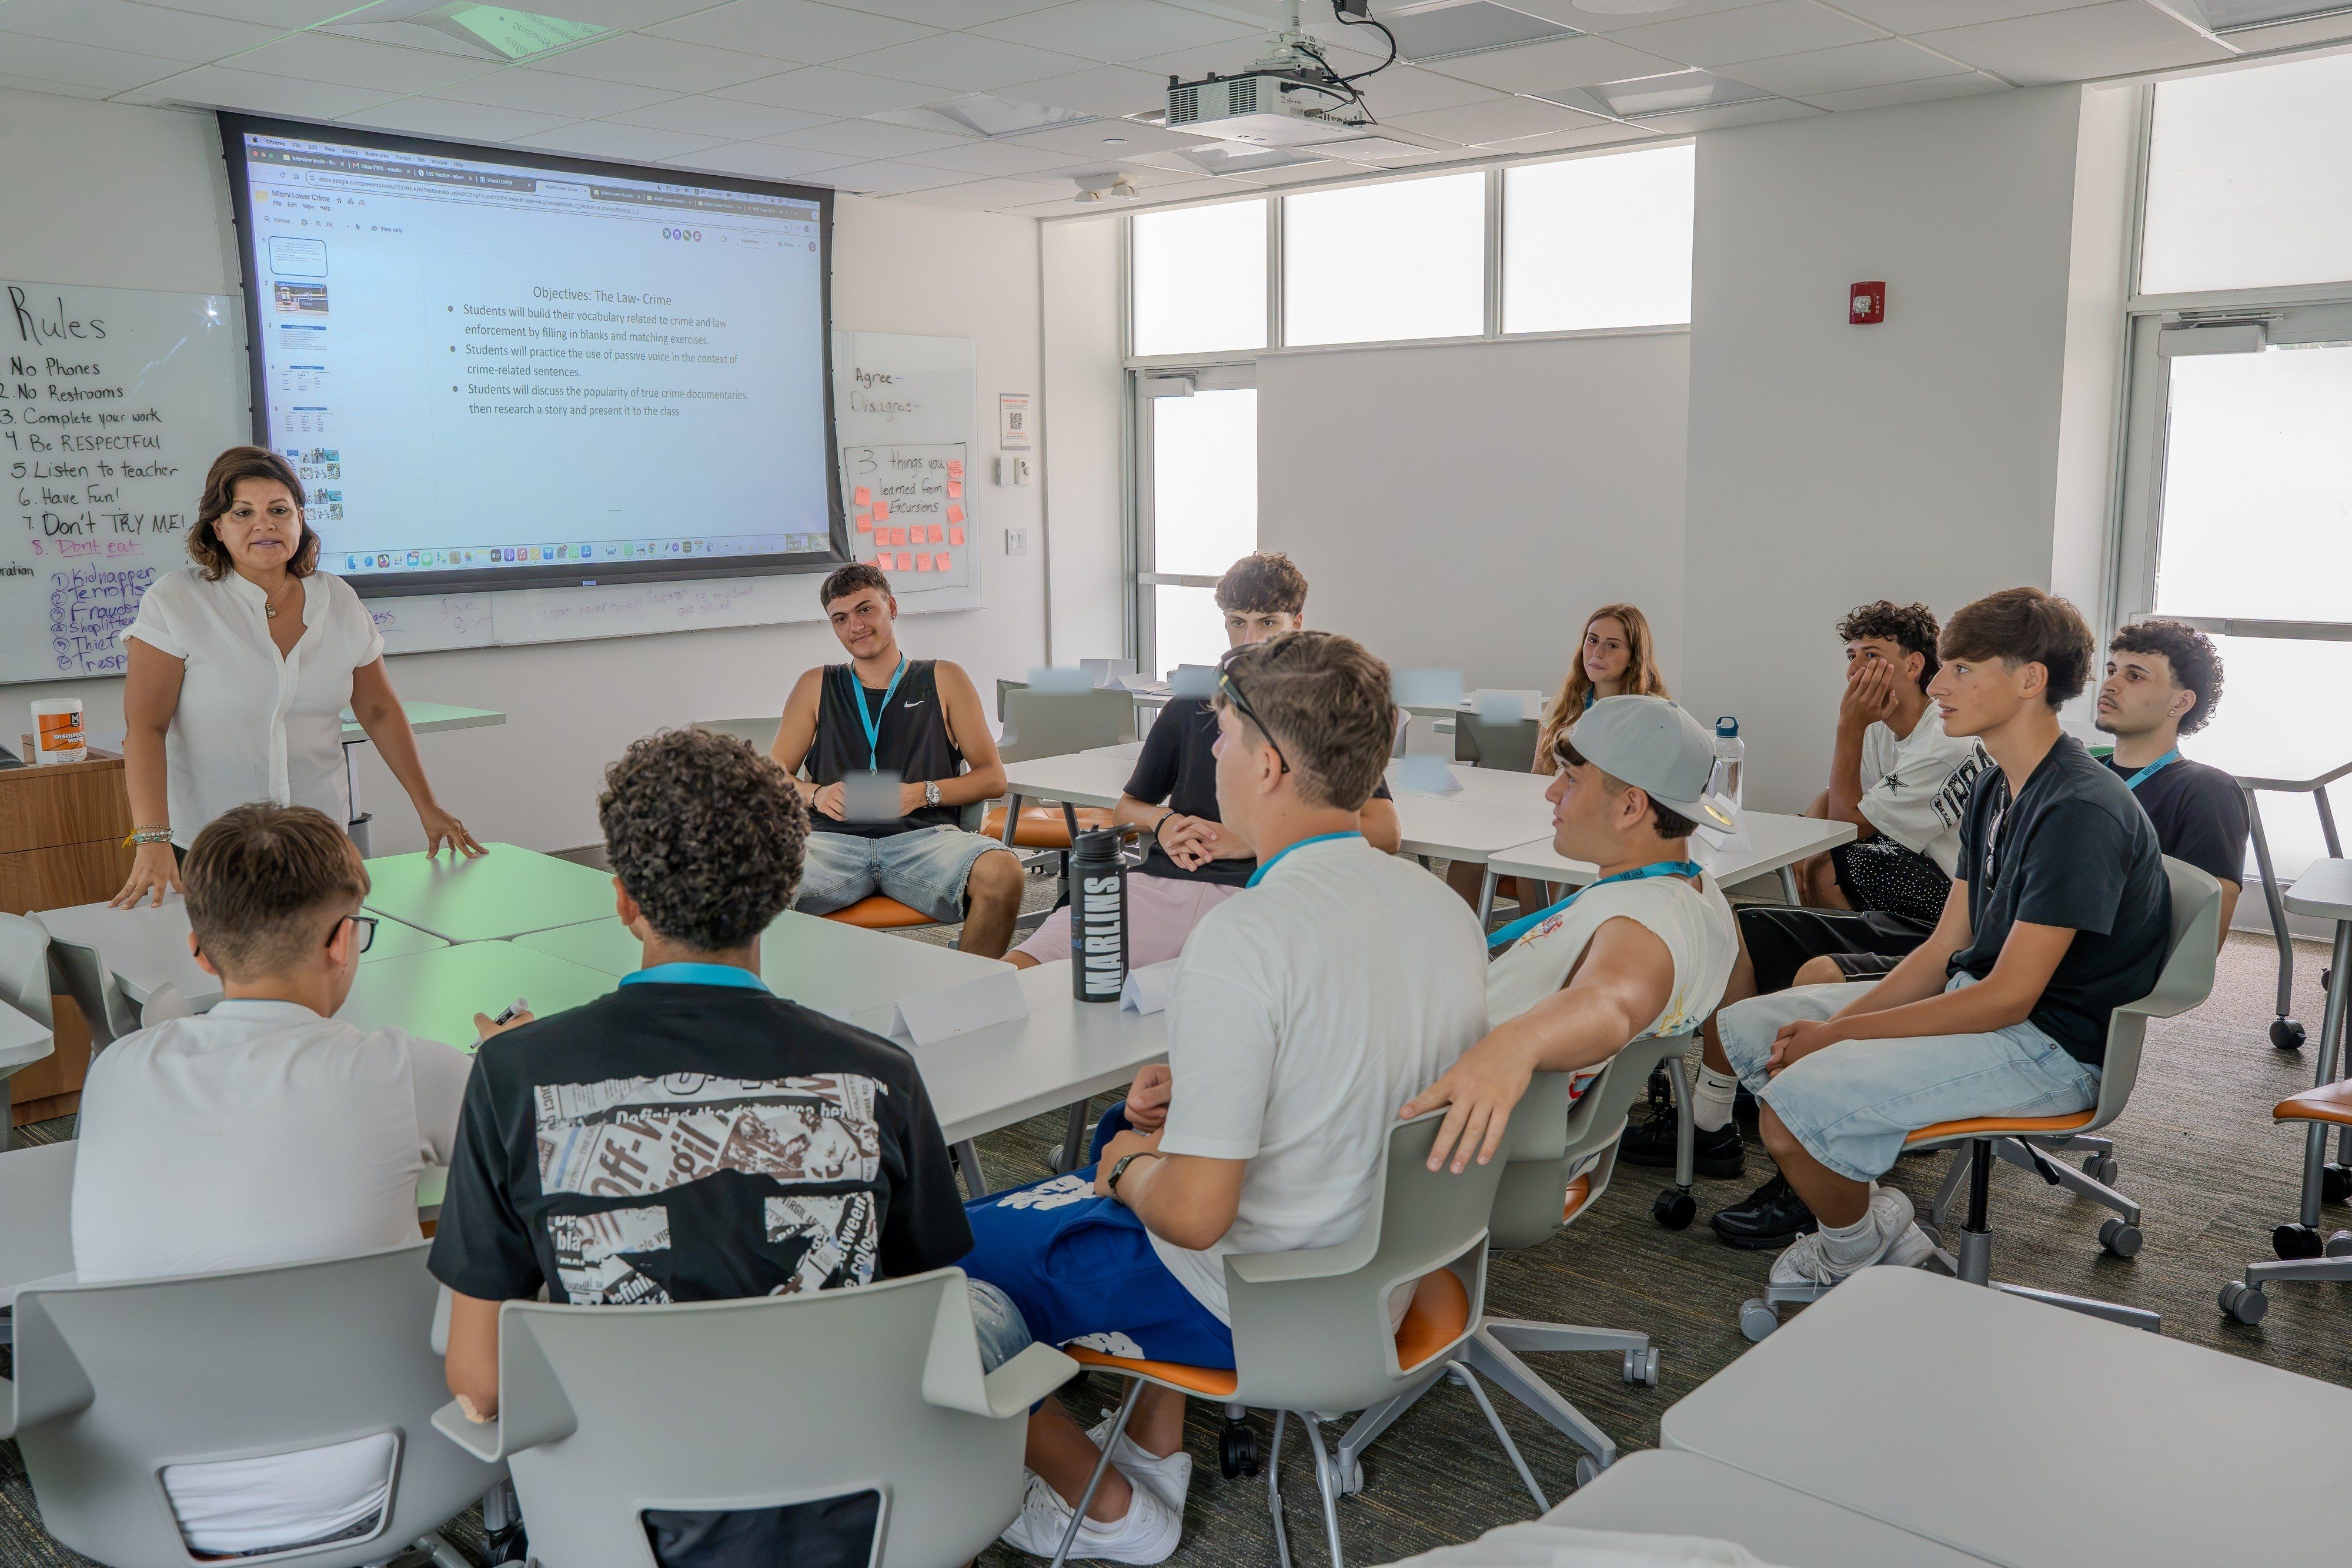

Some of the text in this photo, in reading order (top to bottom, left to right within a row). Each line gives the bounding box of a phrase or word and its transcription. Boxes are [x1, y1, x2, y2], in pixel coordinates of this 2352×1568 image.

[365, 151, 389, 159] Bookmarks
[272, 190, 290, 199] Miami
[312, 194, 330, 202] Crime
[533, 286, 672, 306] Objectives: The Law- Crime
[8, 286, 107, 346] Rules
[463, 305, 727, 327] Students will build their vocabulary related to crime and law
[465, 325, 710, 345] enforcement by filling in blanks and matching exercises.
[466, 345, 738, 364] Students will practice the use of passive voice in the context of
[11, 356, 101, 376] No Phones
[467, 365, 582, 377] crime-related sentences.
[856, 367, 893, 389] Agree
[18, 383, 36, 399] No
[48, 384, 123, 402] Restrooms
[469, 384, 749, 400] Students will discuss the popularity of true crime documentaries,
[24, 407, 93, 429] Complete
[99, 413, 126, 429] your
[132, 407, 162, 423] work
[469, 403, 492, 414] then
[495, 404, 534, 414] research
[545, 406, 566, 416] story
[570, 405, 586, 415] and
[589, 406, 622, 417] present
[624, 406, 630, 415] it
[633, 407, 642, 415] to
[644, 406, 657, 415] the
[660, 406, 680, 416] class
[30, 434, 53, 452] Be
[34, 460, 89, 478] Listen
[97, 459, 113, 477] to
[121, 459, 179, 478] teacher
[858, 449, 877, 474] 3
[888, 448, 923, 479] things
[928, 456, 946, 475] you
[922, 477, 943, 495] from
[42, 487, 80, 505] Have
[889, 498, 940, 513] Excursions
[42, 511, 96, 537] Don't
[101, 513, 145, 535] TRY
[107, 538, 141, 554] eat
[0, 560, 35, 577] ration
[72, 562, 156, 586] Kidnapper
[369, 609, 396, 626] ess
[71, 630, 121, 654] Thief
[1084, 875, 1121, 995] MARLINS
